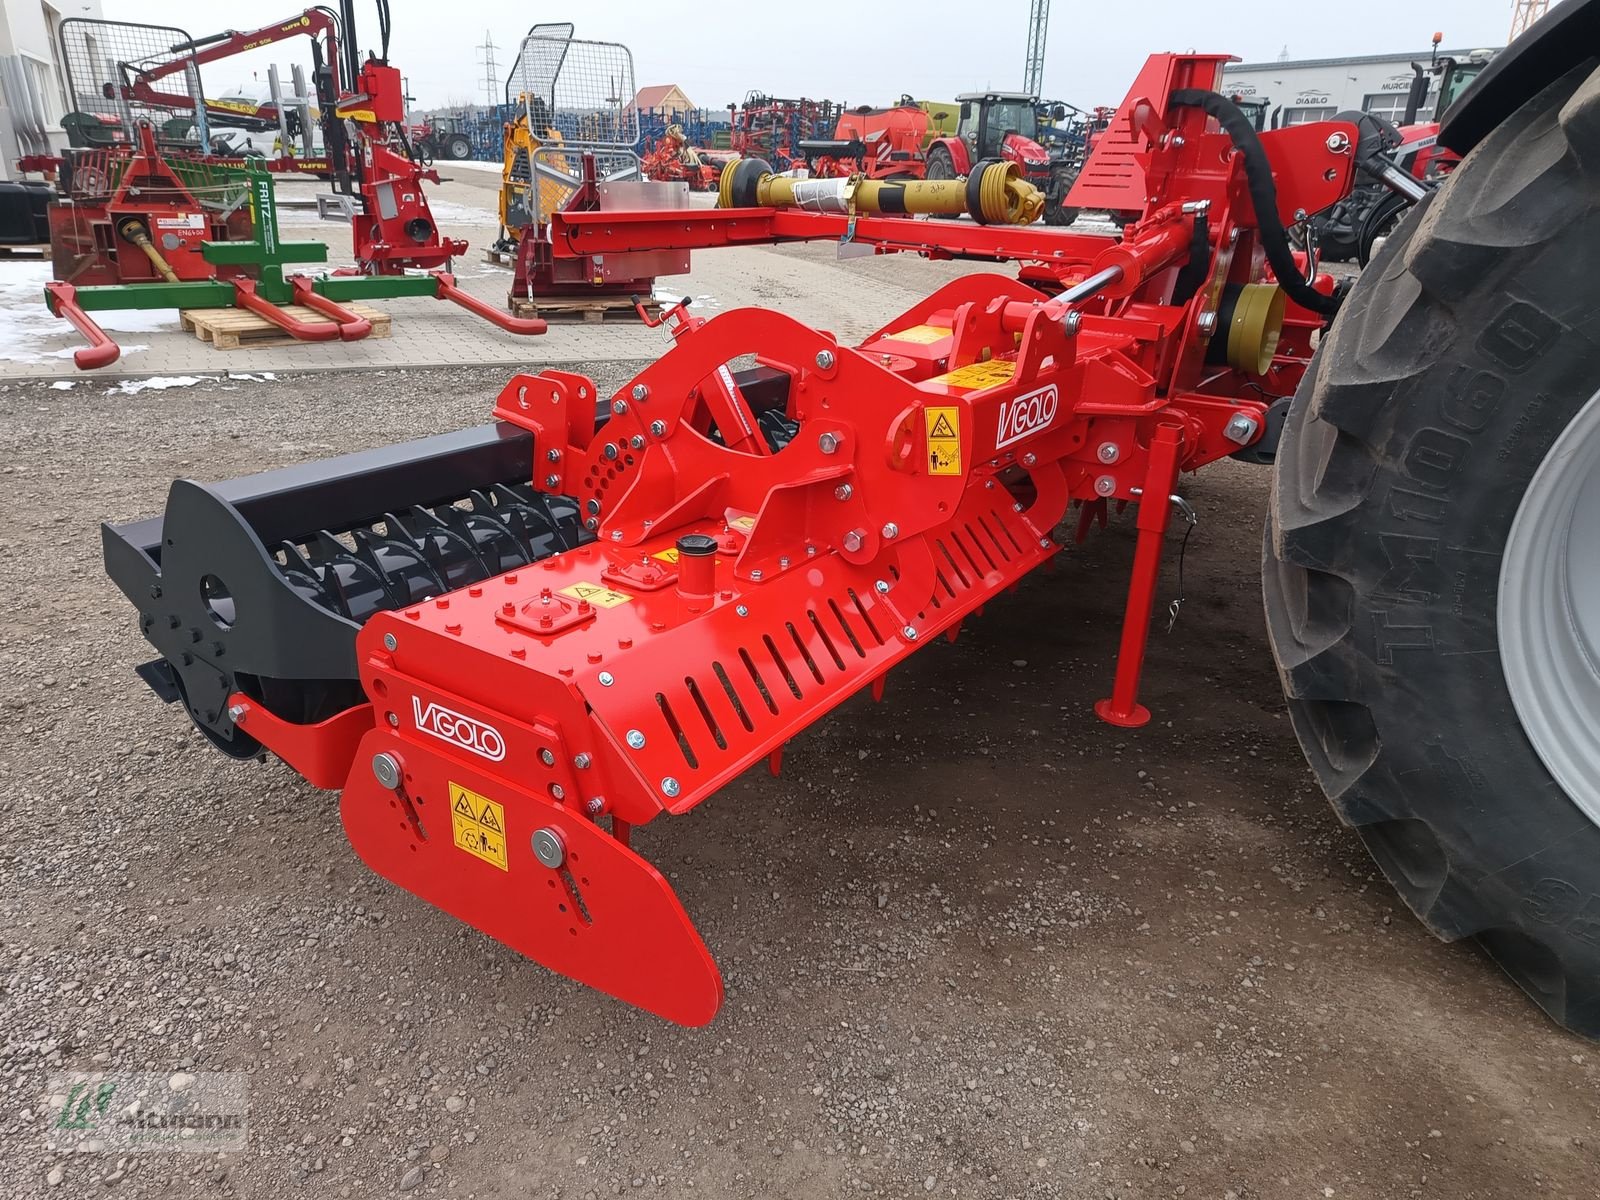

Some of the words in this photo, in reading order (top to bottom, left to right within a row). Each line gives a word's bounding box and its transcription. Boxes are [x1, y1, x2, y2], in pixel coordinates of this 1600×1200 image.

[1295, 97, 1328, 105] DIABLO
[258, 181, 271, 218] FRITZ
[996, 384, 1059, 450] VIGOLO
[412, 695, 506, 761] VIGOLO
